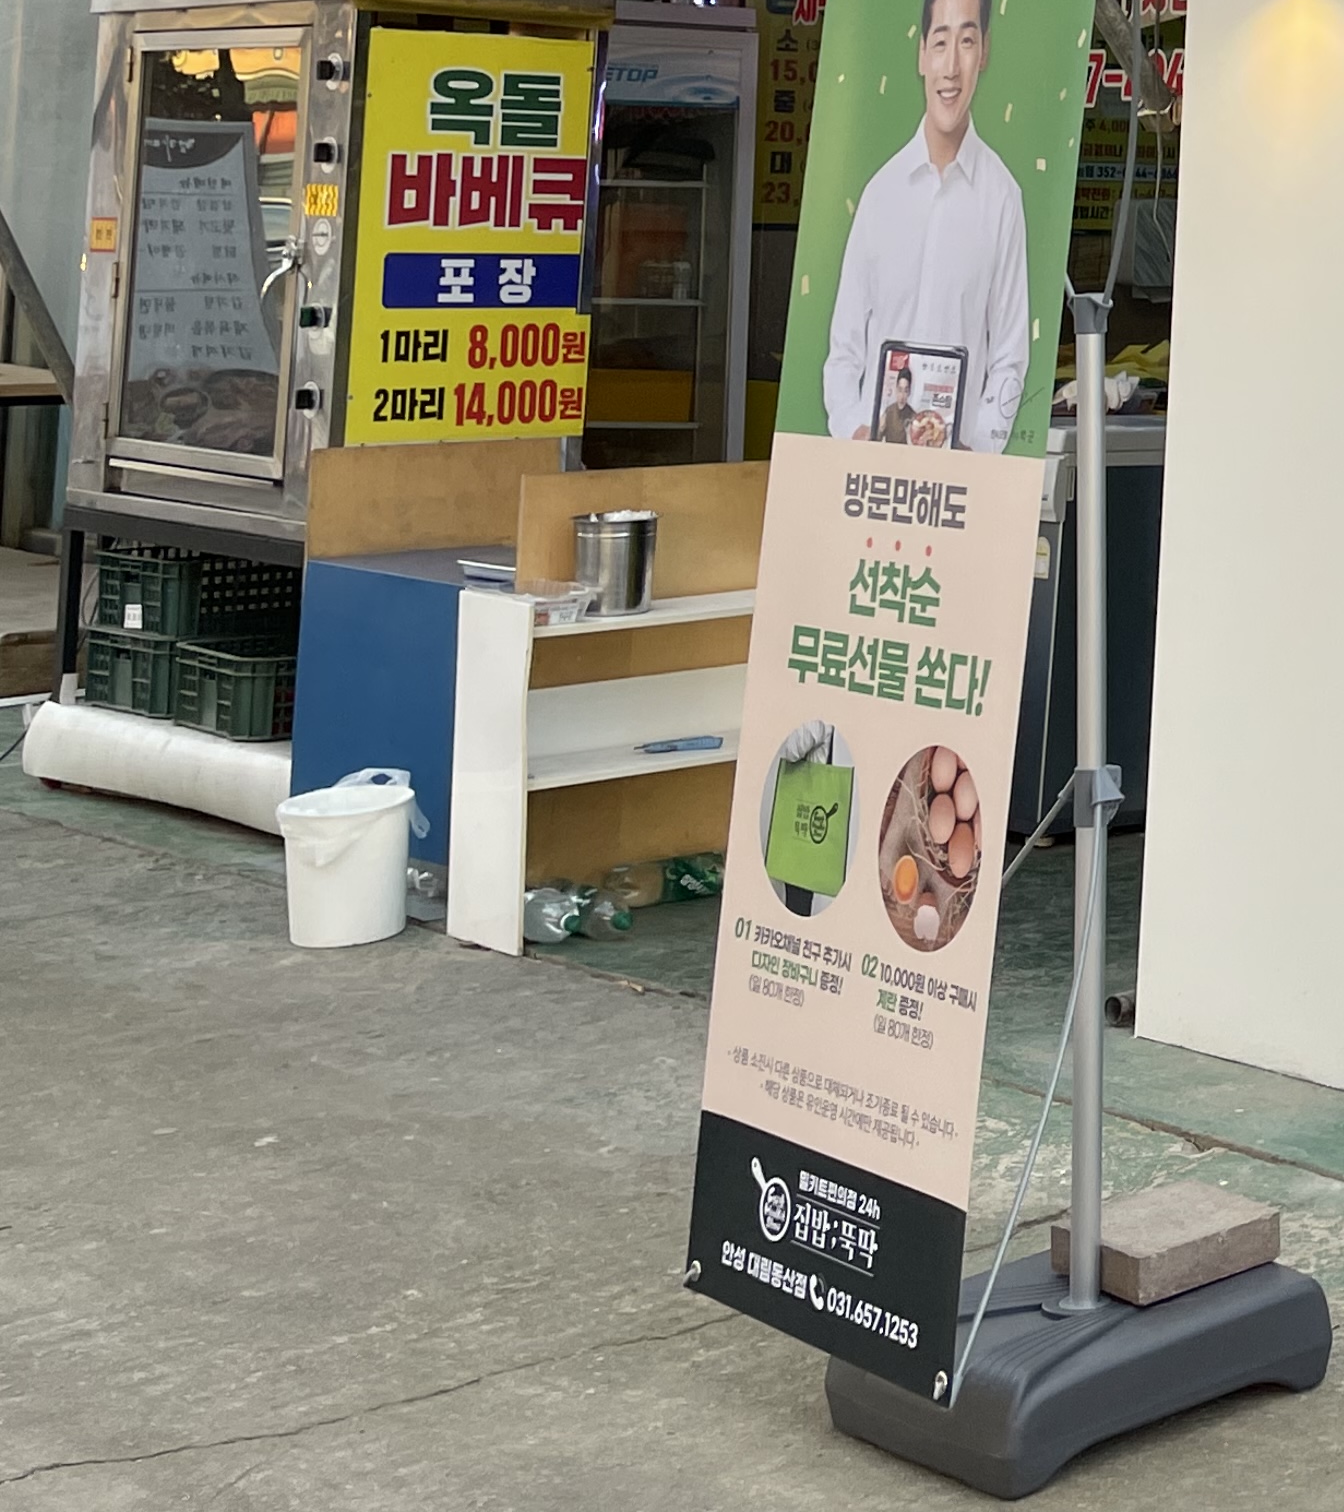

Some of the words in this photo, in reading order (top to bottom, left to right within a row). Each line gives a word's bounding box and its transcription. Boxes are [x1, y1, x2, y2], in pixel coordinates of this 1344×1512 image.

[429, 67, 562, 148] 옥돌
[387, 153, 586, 231] 바베큐
[379, 328, 449, 366] 1마리
[467, 322, 587, 371] 8,000원
[373, 386, 446, 424] 2마리
[453, 379, 585, 427] 14,000원
[843, 472, 968, 530] 방문만해도
[848, 558, 941, 627] 선착순
[787, 624, 910, 702] 무료선물
[914, 644, 993, 717] 쏜다!
[735, 918, 752, 941] 01
[803, 940, 822, 963] 친구
[822, 945, 853, 972] 추가시
[751, 950, 780, 975] 디자인
[781, 958, 819, 987] 장바구니
[861, 953, 878, 978] 02
[927, 977, 948, 1000] 이상
[876, 988, 898, 1013] 계란
[858, 1193, 881, 1221] 24h
[720, 1240, 745, 1272] 안성
[747, 1251, 808, 1300] 대림동산점
[826, 1286, 919, 1349] 031.657.1253
